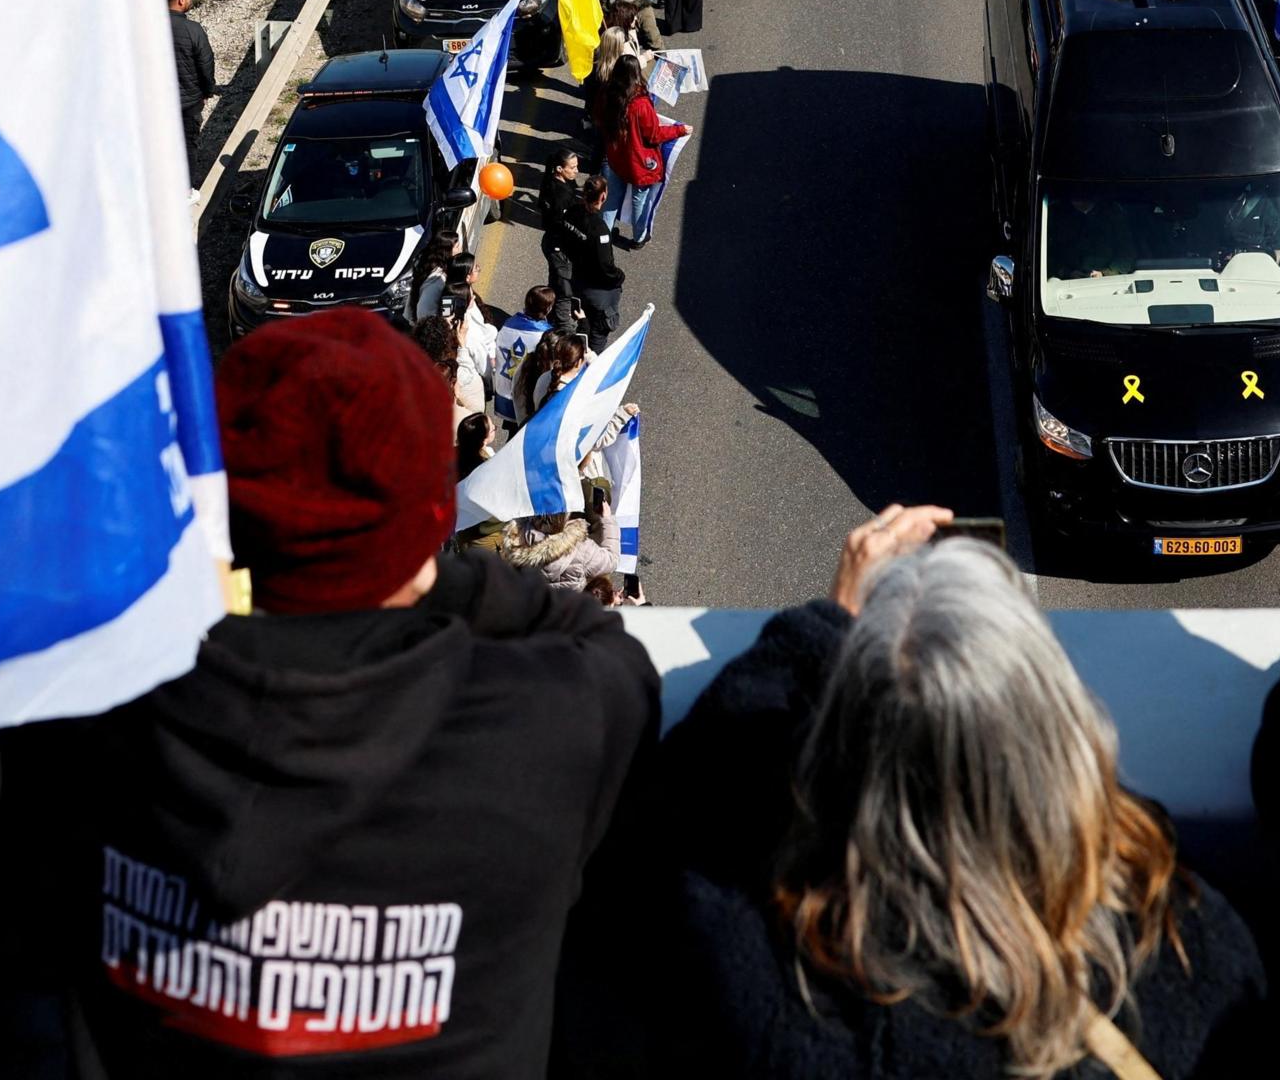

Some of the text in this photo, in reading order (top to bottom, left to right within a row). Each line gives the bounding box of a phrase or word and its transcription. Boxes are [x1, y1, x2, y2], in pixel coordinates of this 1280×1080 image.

[271, 267, 385, 280] פיקוח עירוני
[381, 903, 463, 961] מטה
[257, 956, 456, 1033] החטופים
